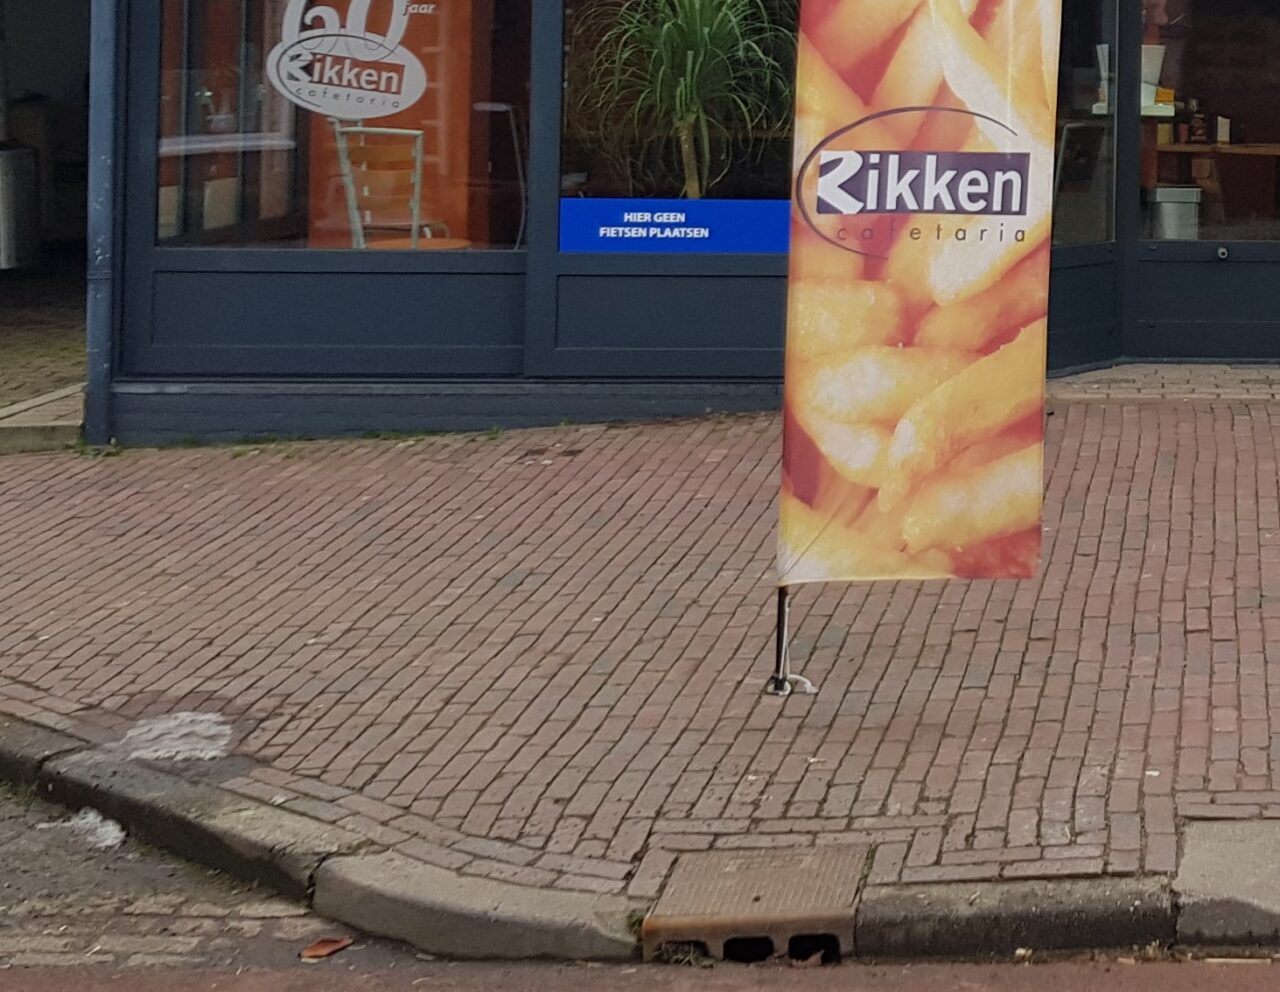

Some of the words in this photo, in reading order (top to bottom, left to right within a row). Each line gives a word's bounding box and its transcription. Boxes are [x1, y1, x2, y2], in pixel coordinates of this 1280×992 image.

[402, 1, 436, 16] jaar
[285, 51, 400, 93] Rikken
[296, 87, 400, 108] cafetaria
[818, 151, 1023, 214] Rikken
[624, 212, 652, 223] HIER
[653, 212, 686, 223] GEEN
[599, 226, 647, 238] FIETSEN
[649, 227, 710, 239] PLAATSEN
[837, 217, 1025, 243] cafetaria
